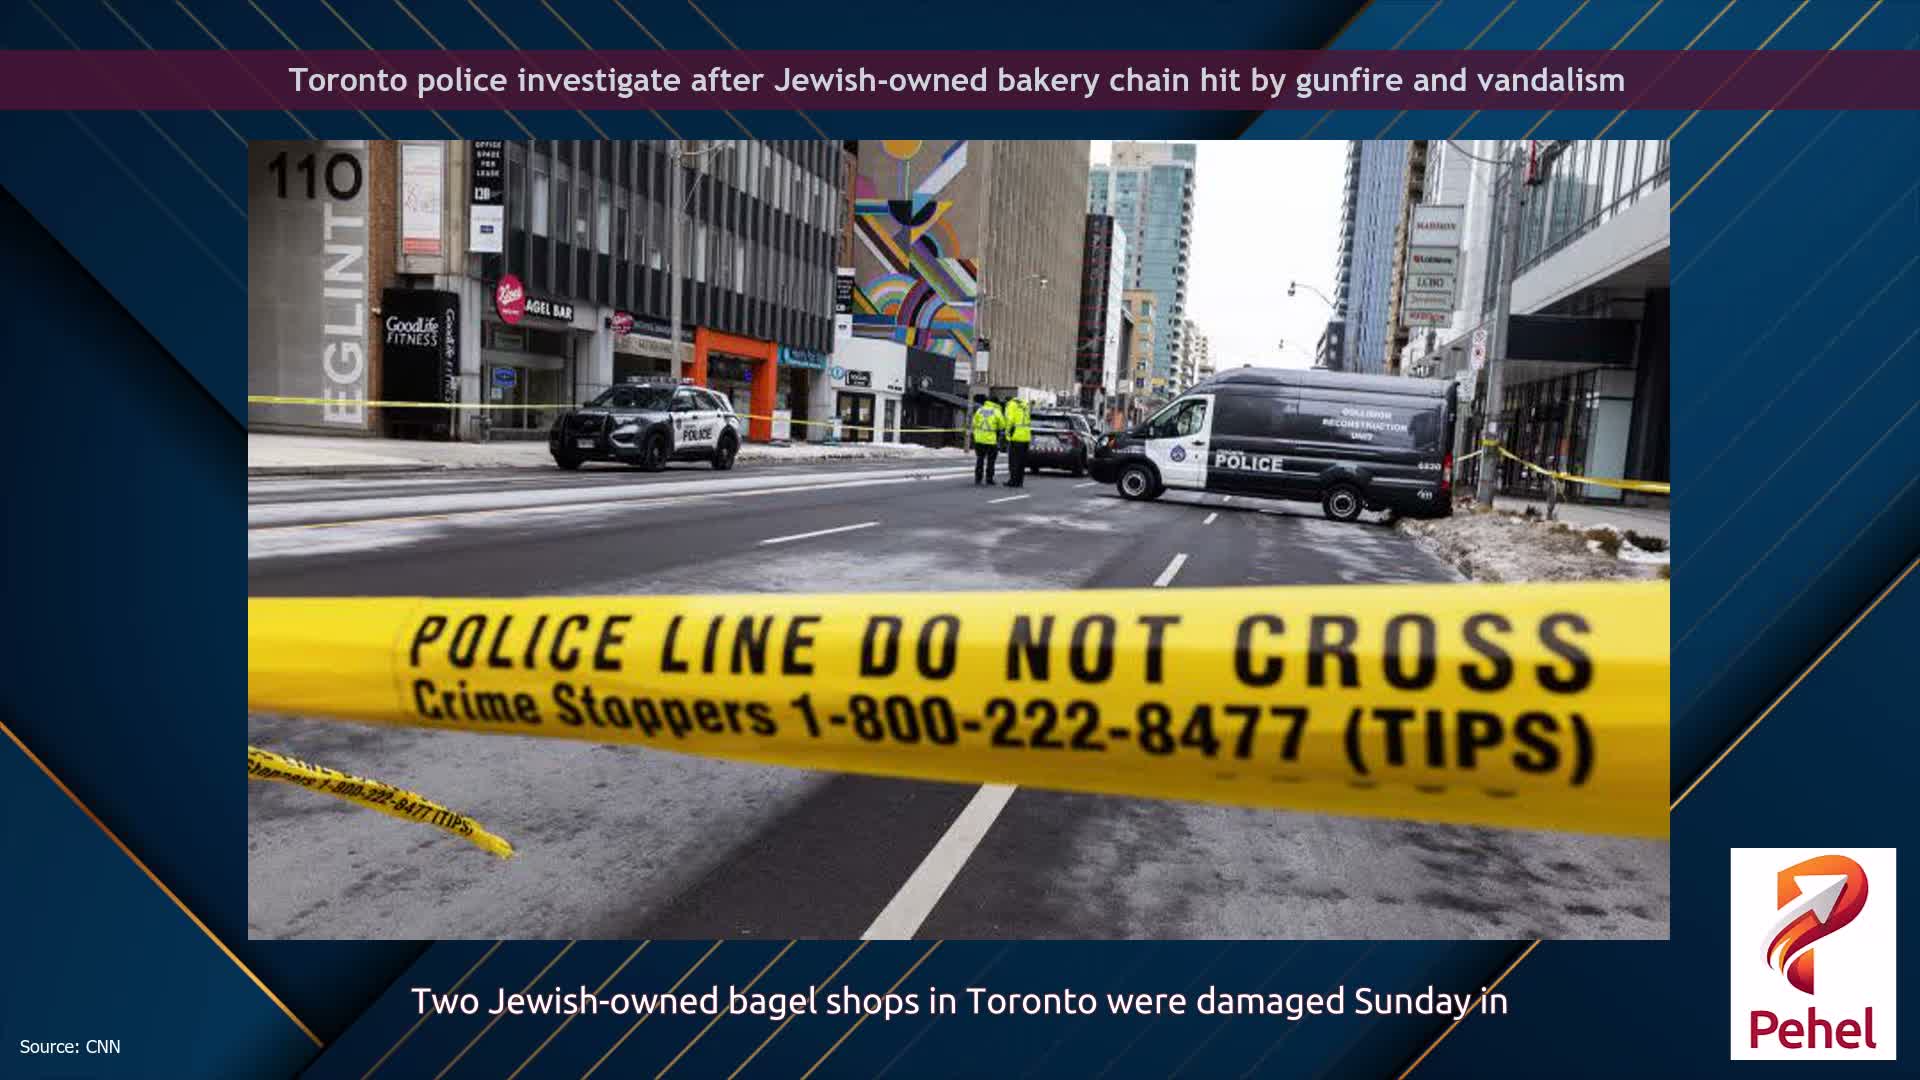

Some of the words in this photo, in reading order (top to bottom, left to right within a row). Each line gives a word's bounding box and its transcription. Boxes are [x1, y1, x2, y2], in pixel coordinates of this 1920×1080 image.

[267, 151, 362, 201] 110
[524, 299, 551, 316] AGEL
[552, 304, 573, 319] BAR
[386, 331, 438, 347] FITNESS
[683, 429, 712, 441] POLICE
[1322, 418, 1408, 432] RECONSTRUCTION
[1215, 454, 1284, 473] POLICE
[409, 614, 633, 672] POLICE
[660, 614, 822, 676] LINE
[859, 614, 960, 680] DO
[1006, 613, 1182, 685] NOT
[1234, 612, 1595, 695] CROSS
[412, 677, 542, 727] Crime
[552, 683, 778, 739] Stoppers
[791, 694, 1309, 762] 1-800-222-8477
[1344, 706, 1595, 788] (TIPS)
[431, 808, 474, 837] (TIPS)
